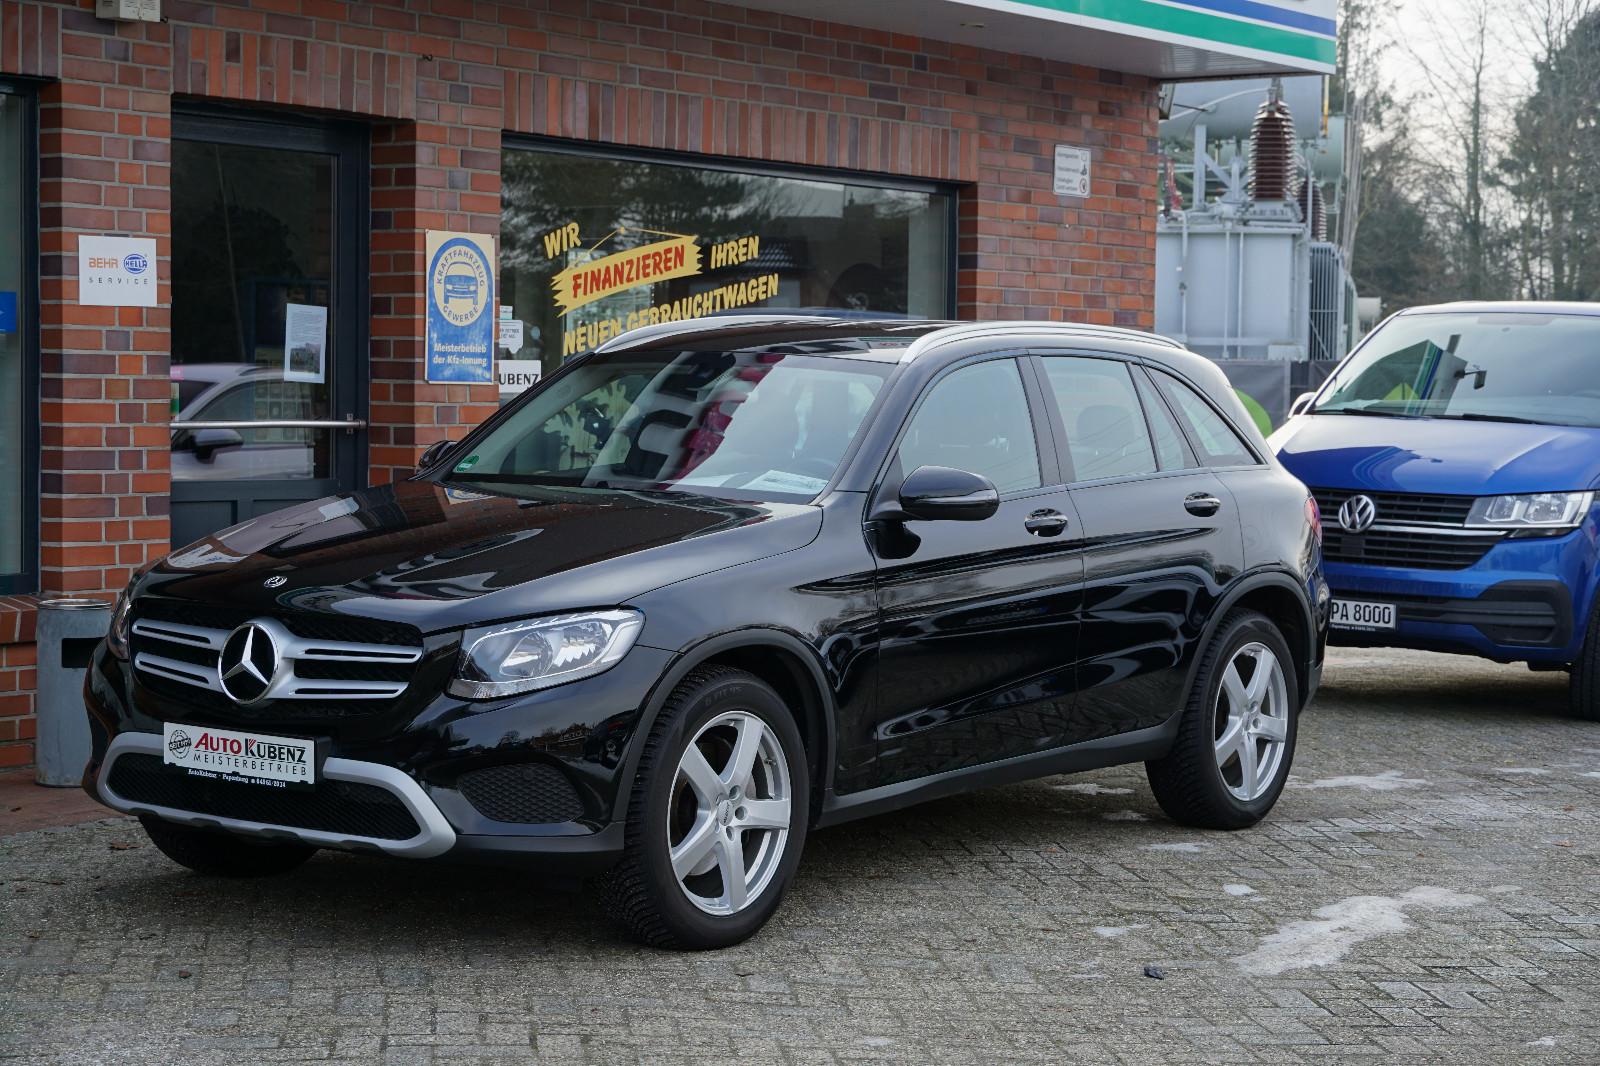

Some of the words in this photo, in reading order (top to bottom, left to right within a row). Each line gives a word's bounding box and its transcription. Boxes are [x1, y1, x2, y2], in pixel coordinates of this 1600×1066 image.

[88, 258, 118, 268] BEHR
[436, 248, 485, 287] KRAFTFAHRZEUG
[544, 222, 582, 260] WIR
[572, 244, 685, 298] FINANZIEREN
[710, 235, 760, 270] IHREN
[443, 305, 480, 323] GEWERBE
[563, 317, 622, 356] NEUEN
[627, 273, 779, 331] GEBRAUCHTWAGEN
[433, 343, 487, 353] Meisterbetrieb
[433, 354, 446, 364] der
[499, 373, 540, 385] UBENZ
[1330, 602, 1349, 621] PA
[1353, 604, 1391, 624] 8000
[194, 732, 243, 755] AUTO
[245, 738, 306, 764] KUBENZ
[193, 753, 307, 776] MEISTERBETRIEB
